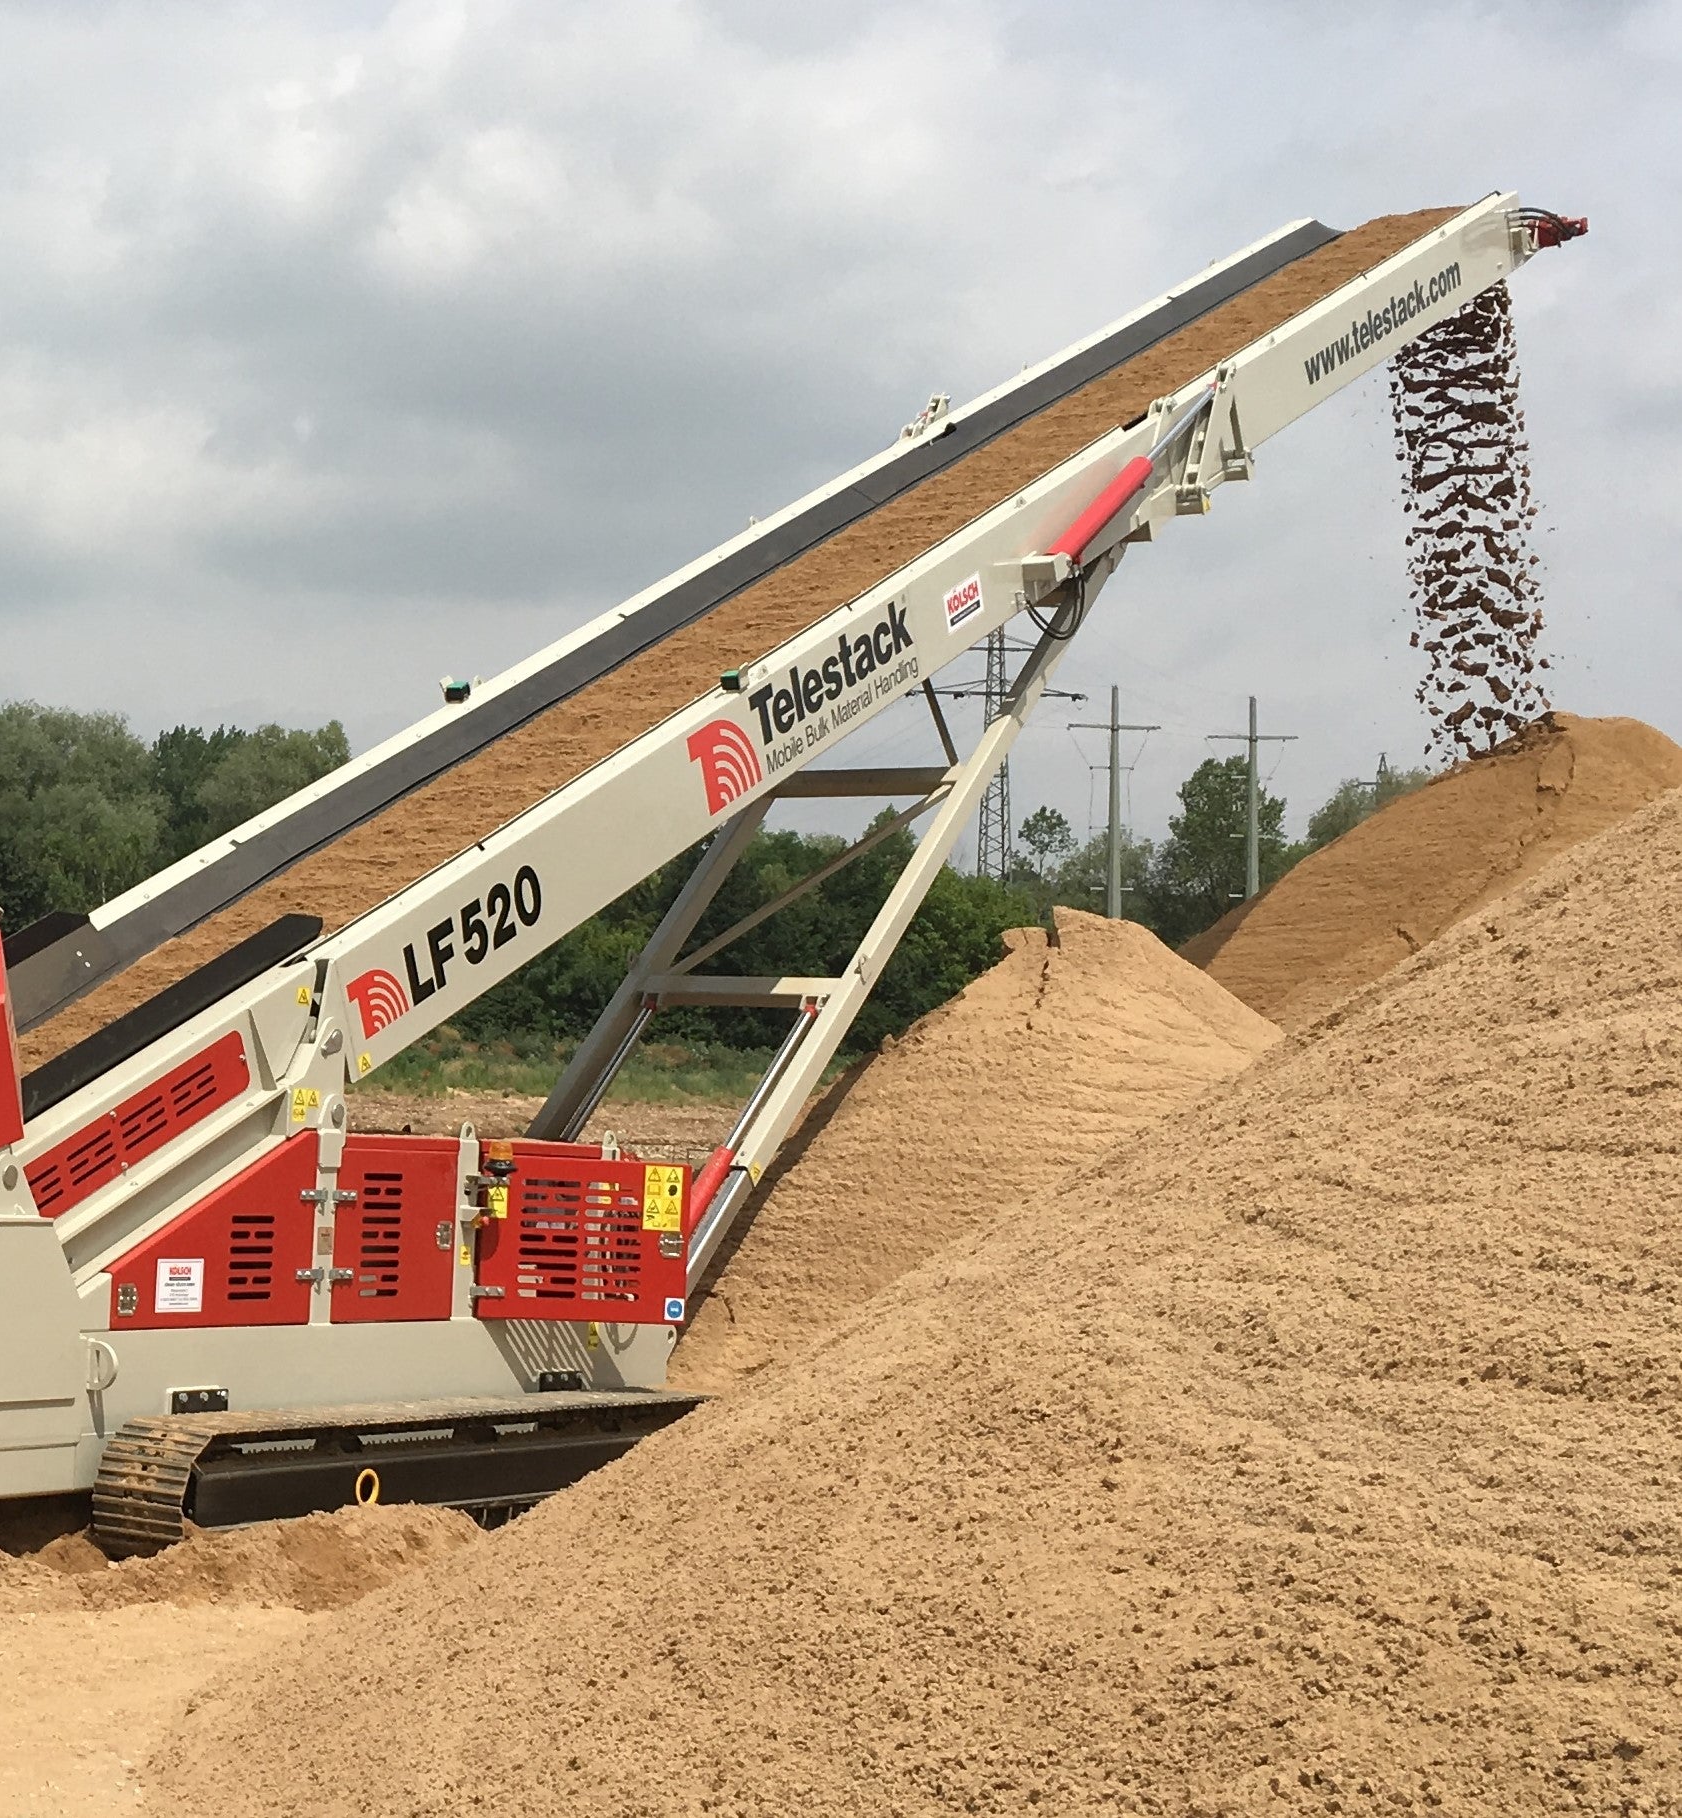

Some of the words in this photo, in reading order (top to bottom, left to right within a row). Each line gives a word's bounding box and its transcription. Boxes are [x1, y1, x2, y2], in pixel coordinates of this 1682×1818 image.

[1304, 262, 1461, 384] www.telestack.com
[748, 601, 914, 746] Telestack
[766, 737, 804, 774] Mobile
[805, 716, 830, 748] Bulk
[831, 683, 873, 729] Material
[874, 657, 919, 699] Handling
[403, 865, 541, 1006] LF520
